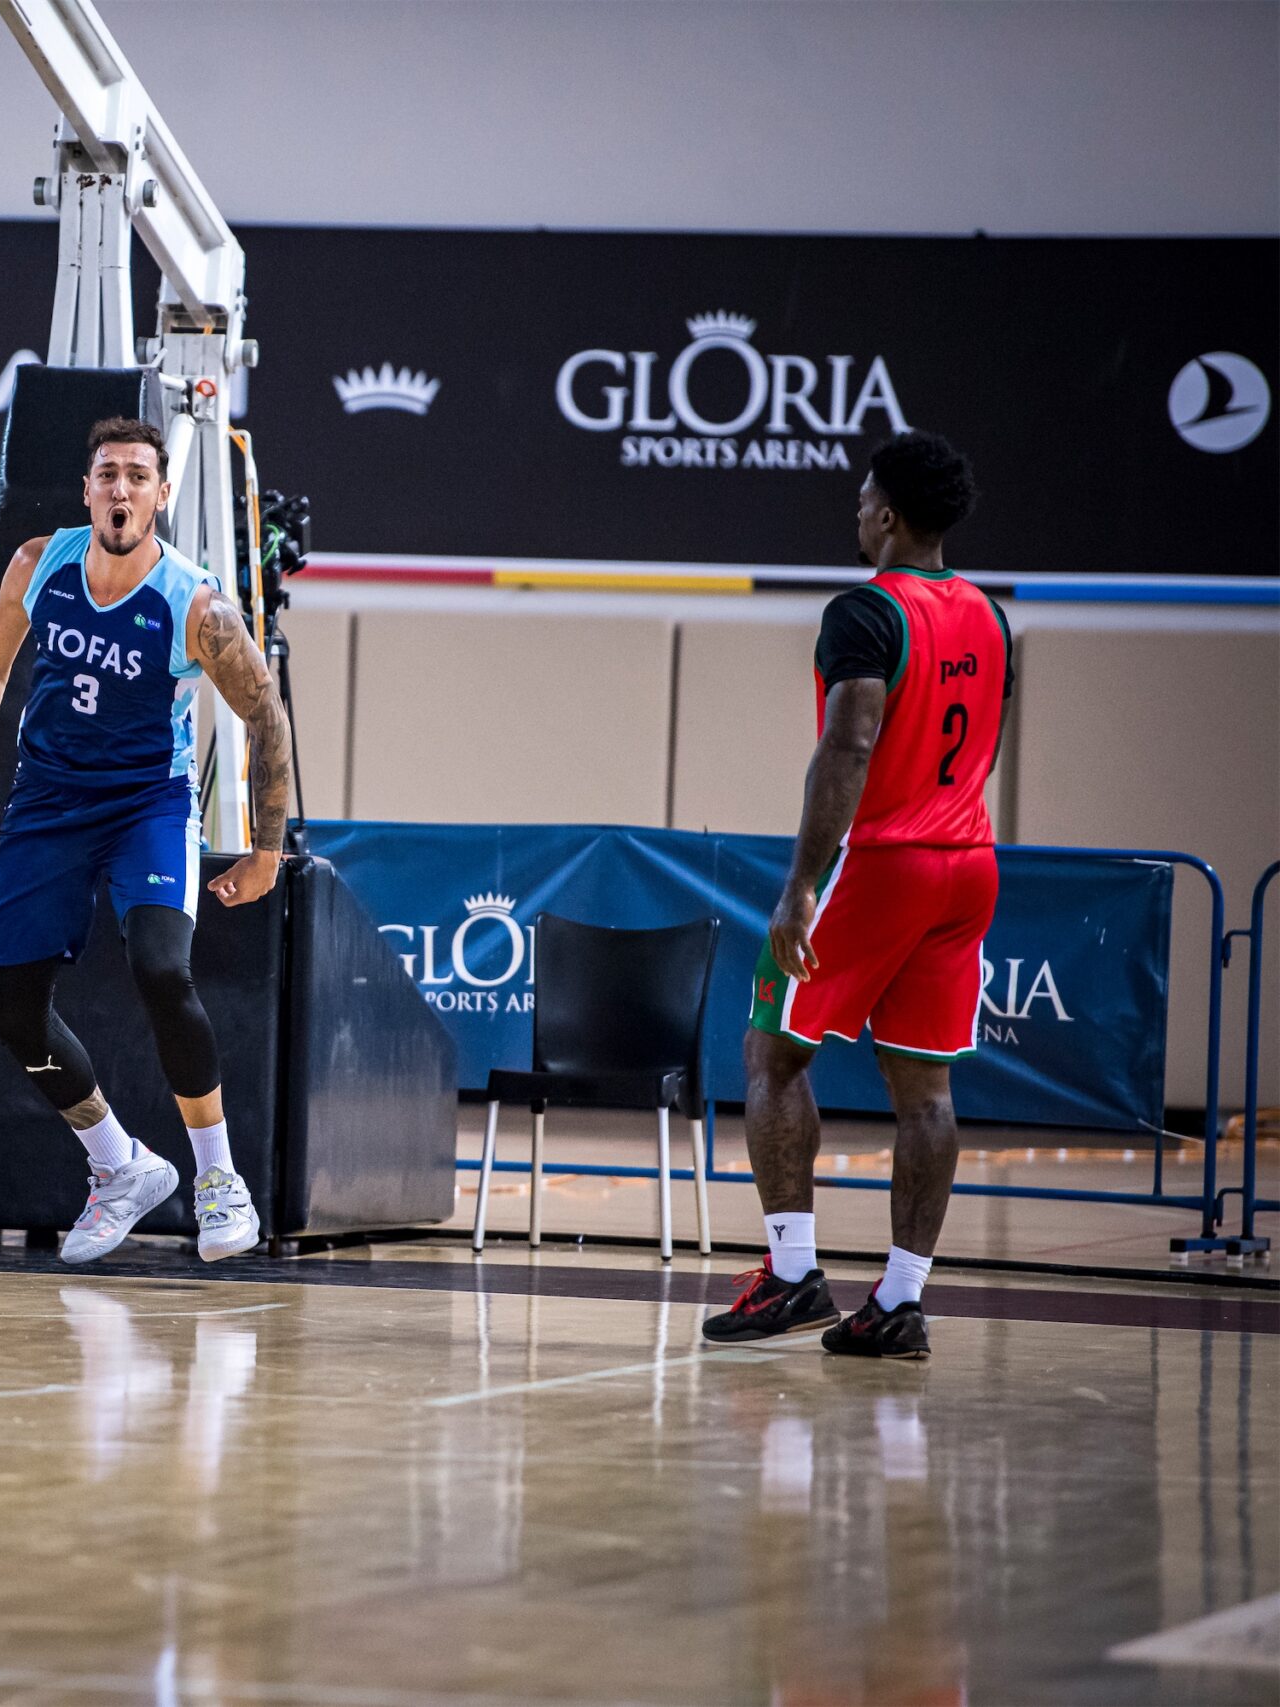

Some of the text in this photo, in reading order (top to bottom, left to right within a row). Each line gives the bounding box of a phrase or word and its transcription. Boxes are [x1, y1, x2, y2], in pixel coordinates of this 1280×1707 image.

[556, 333, 915, 436] GLORIA
[621, 435, 851, 472] SPORTS ARENA
[48, 588, 75, 600] HEAD
[47, 621, 142, 681] TOFAŞ
[71, 673, 100, 715] 3
[938, 703, 969, 786] 2
[423, 990, 499, 1013] PORTS
[981, 957, 1076, 1022] RIA
